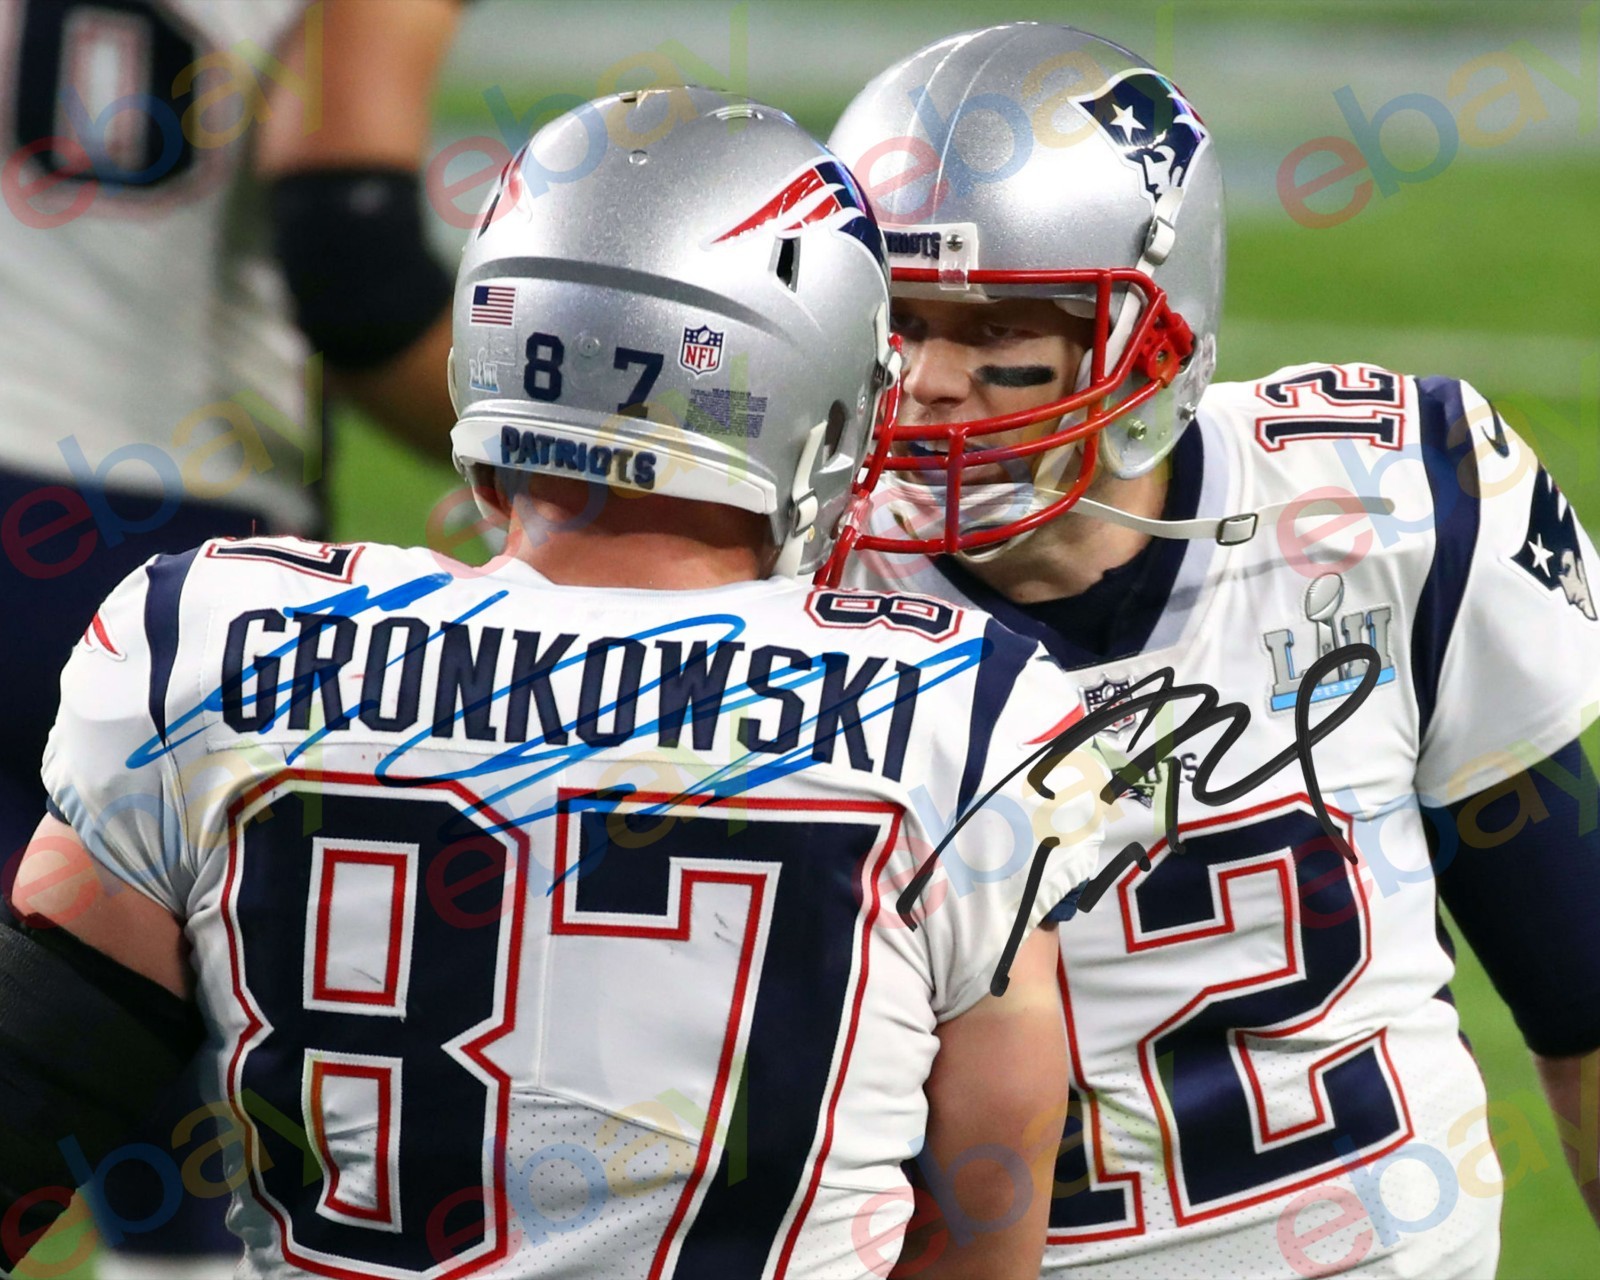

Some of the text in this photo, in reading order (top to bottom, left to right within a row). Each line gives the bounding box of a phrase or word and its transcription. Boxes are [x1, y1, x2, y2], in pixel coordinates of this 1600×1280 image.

[524, 332, 564, 401] 8
[613, 347, 664, 418] 7
[685, 344, 717, 370] NFL
[1255, 364, 1406, 453] 12
[500, 425, 657, 491] PATRIOTS
[221, 607, 921, 783] GRONKOWSKI
[222, 767, 907, 1280] 87
